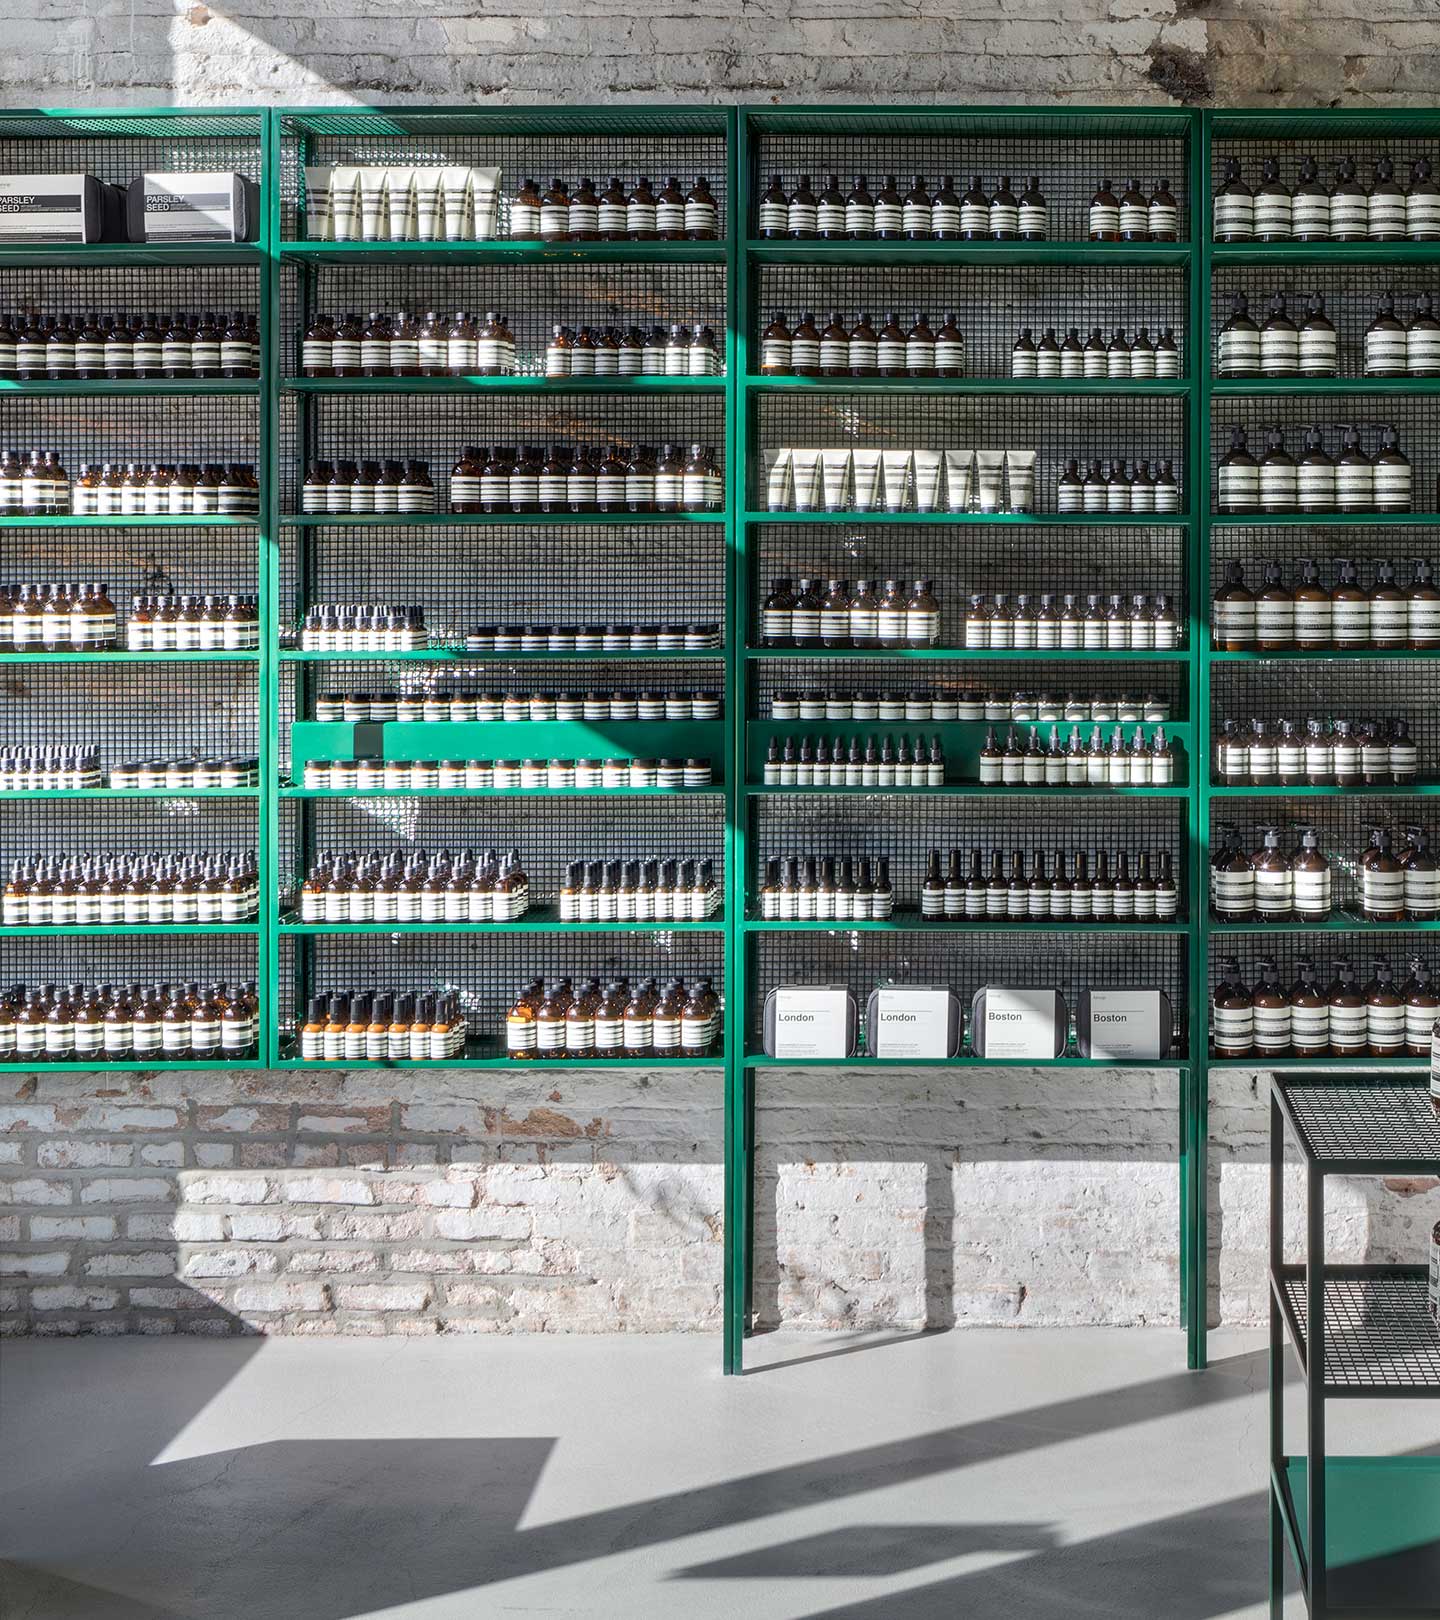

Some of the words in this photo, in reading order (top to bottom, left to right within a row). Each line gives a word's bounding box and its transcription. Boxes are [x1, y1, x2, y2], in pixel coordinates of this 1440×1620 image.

[0, 196, 35, 204] ARSLEY
[146, 195, 185, 203] PARSLEY
[146, 204, 170, 212] SEED
[778, 1013, 815, 1022] London
[880, 1013, 917, 1022] London
[988, 1012, 1022, 1021] Boston
[1093, 1014, 1127, 1023] Boston
